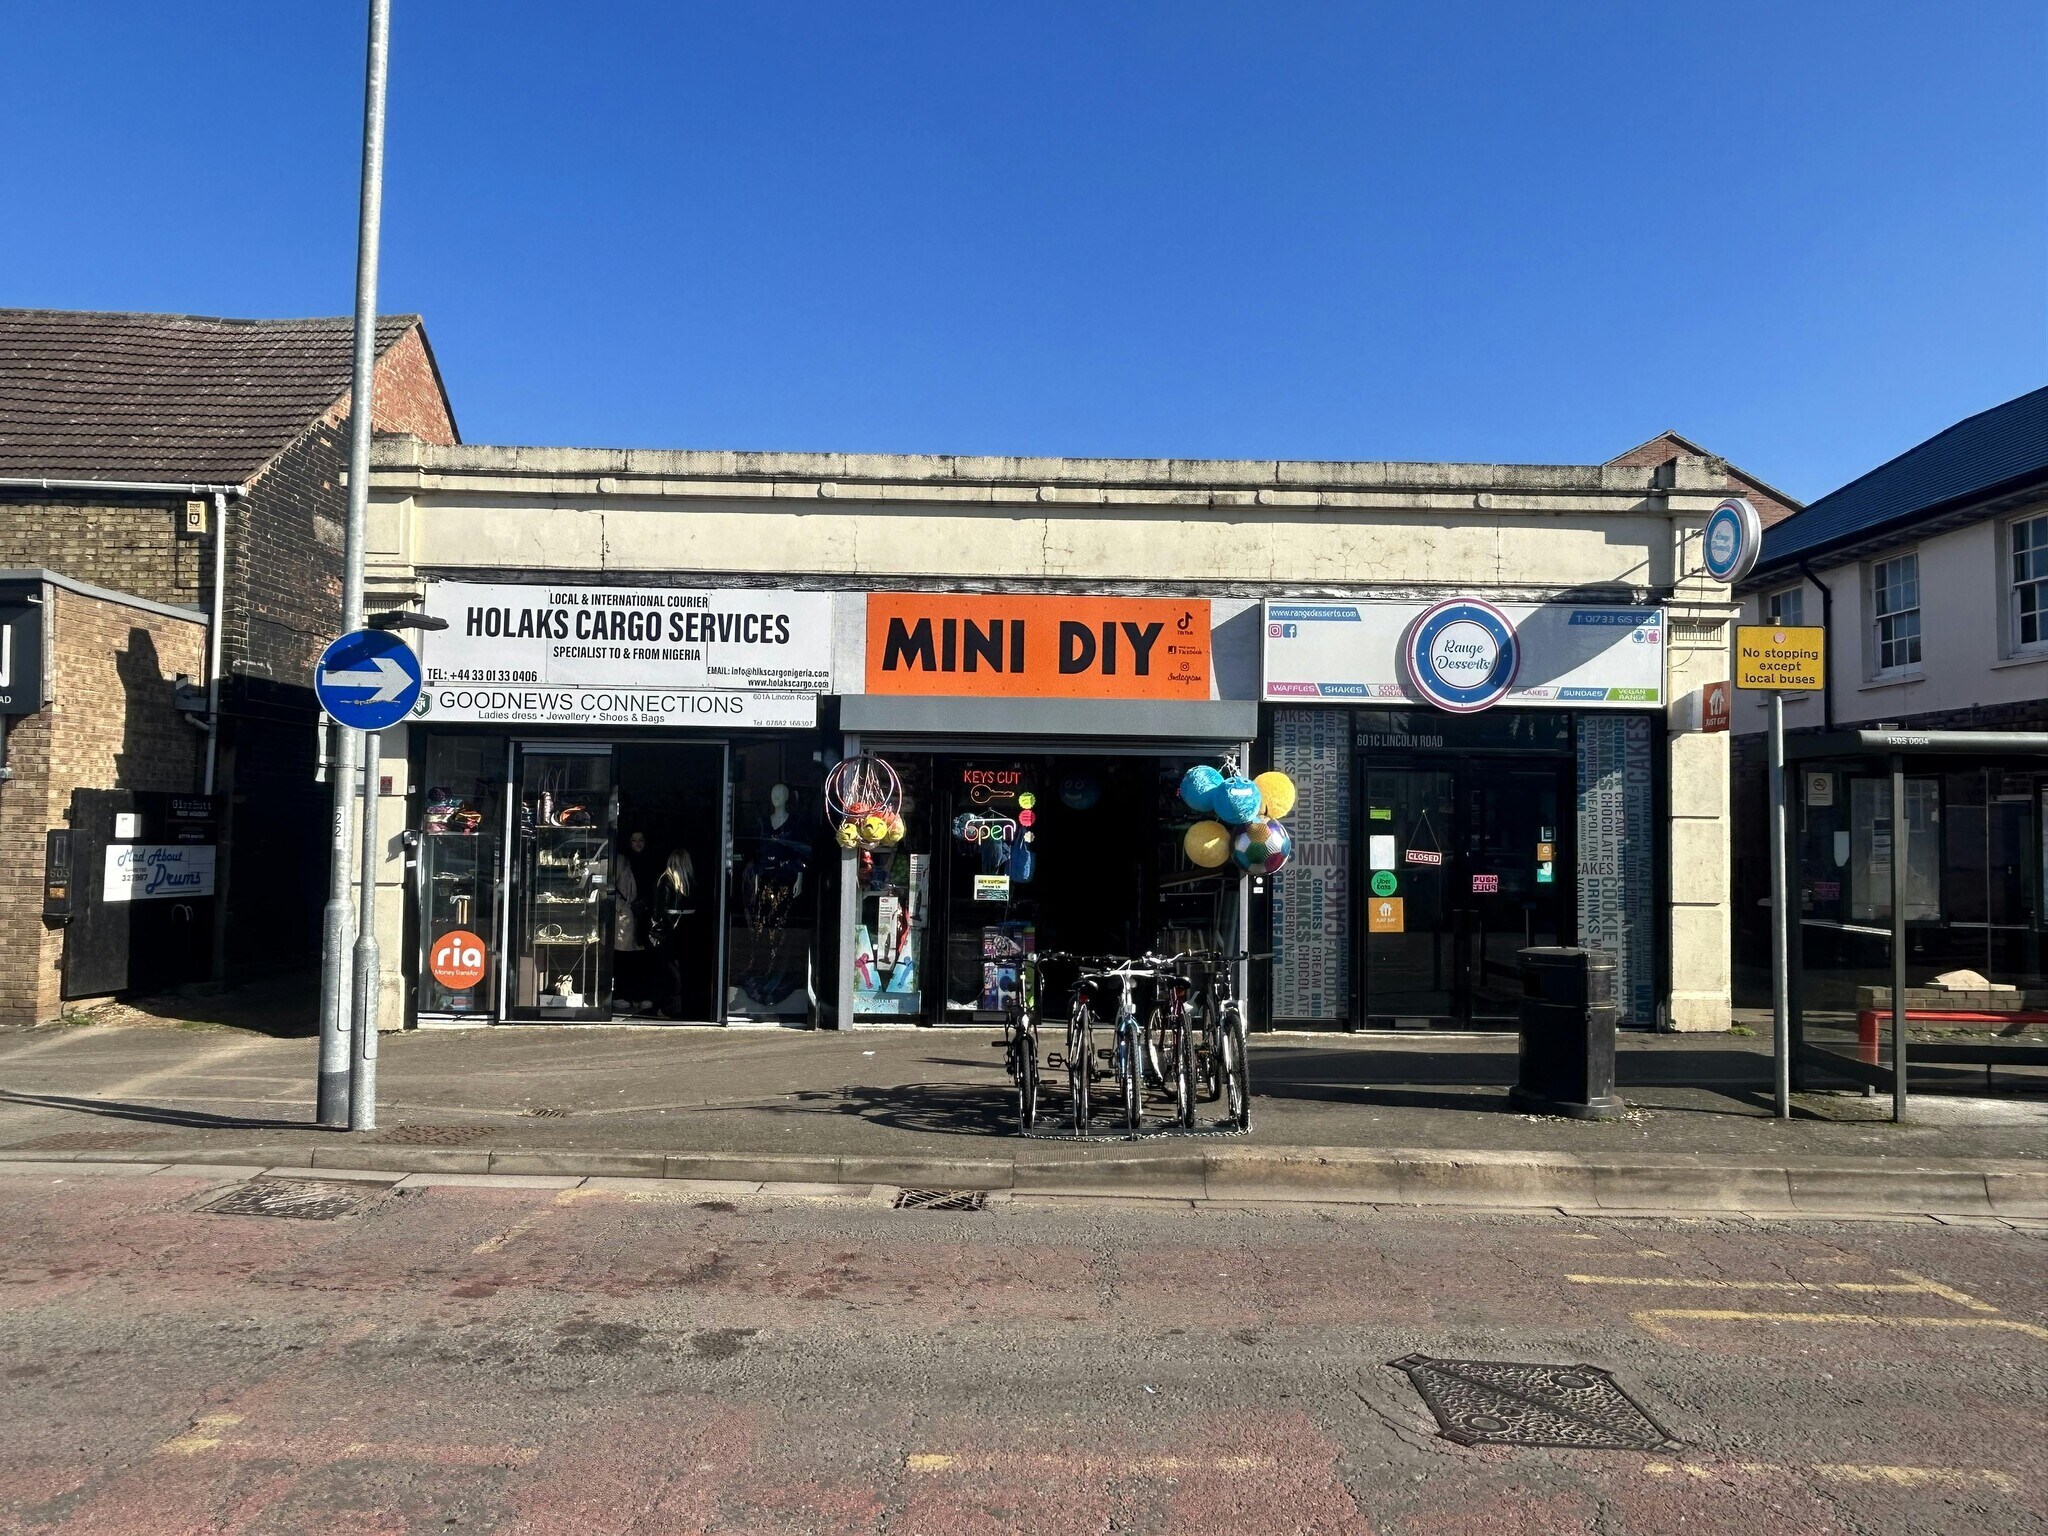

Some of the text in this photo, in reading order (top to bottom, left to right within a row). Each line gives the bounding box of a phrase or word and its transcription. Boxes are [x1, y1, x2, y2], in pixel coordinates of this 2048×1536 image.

[550, 593, 708, 609] LOCAL & INTERNATIONAL COURIER
[466, 606, 791, 645] HOLAKS CARGO SERVICES
[553, 646, 701, 662] SPECIALIST TO & FROM NIGERIA
[882, 617, 1165, 676] MINI DIY
[1444, 639, 1485, 659] Range
[1743, 647, 1819, 661] No stopping
[427, 668, 448, 681] TEL:
[450, 670, 470, 682] +44
[472, 670, 484, 682] 33
[498, 670, 510, 682] 33
[512, 670, 538, 683] 0406
[1435, 655, 1491, 670] Desserts
[1759, 661, 1802, 673] except
[1272, 684, 1316, 693] WAFFLES
[1324, 685, 1363, 694] SHAKES
[1745, 673, 1816, 684] local buses
[440, 691, 744, 714] GOODNEWS CONNECTIONS
[1563, 690, 1604, 698] SUNDAES
[478, 710, 665, 724] Ladies dress Jewellery Shoes & Bags
[1284, 724, 1296, 775] DRINKS
[1325, 737, 1335, 768] PUPPY
[1356, 734, 1444, 748] 601C LINCOLN ROAD
[1626, 718, 1650, 784] CAKES
[963, 770, 1021, 785] KEYS CUT
[1298, 725, 1312, 842] COOKIE DOUGH
[1587, 719, 1598, 861] STRAWBERRY NEAPOLITAN
[1313, 763, 1324, 843] STRAWBERRY
[964, 818, 1017, 846] open
[1601, 793, 1614, 862] CHOCOLATE
[147, 848, 183, 866] About
[1298, 843, 1349, 866] MINT
[1408, 853, 1440, 863] CLOSED
[145, 863, 201, 894] Drums
[1285, 869, 1296, 941] STRAWBERRY
[1312, 878, 1323, 930] COOKIES
[1324, 868, 1346, 936] CAKES
[1587, 878, 1600, 934] DRINKS
[1601, 876, 1618, 942] COOKIE
[437, 937, 482, 968] ria
[1296, 868, 1312, 1017] SHAKES CHOCOLATE
[1284, 943, 1295, 1016] NEAPOLITAN
[1312, 946, 1322, 988] CREAM
